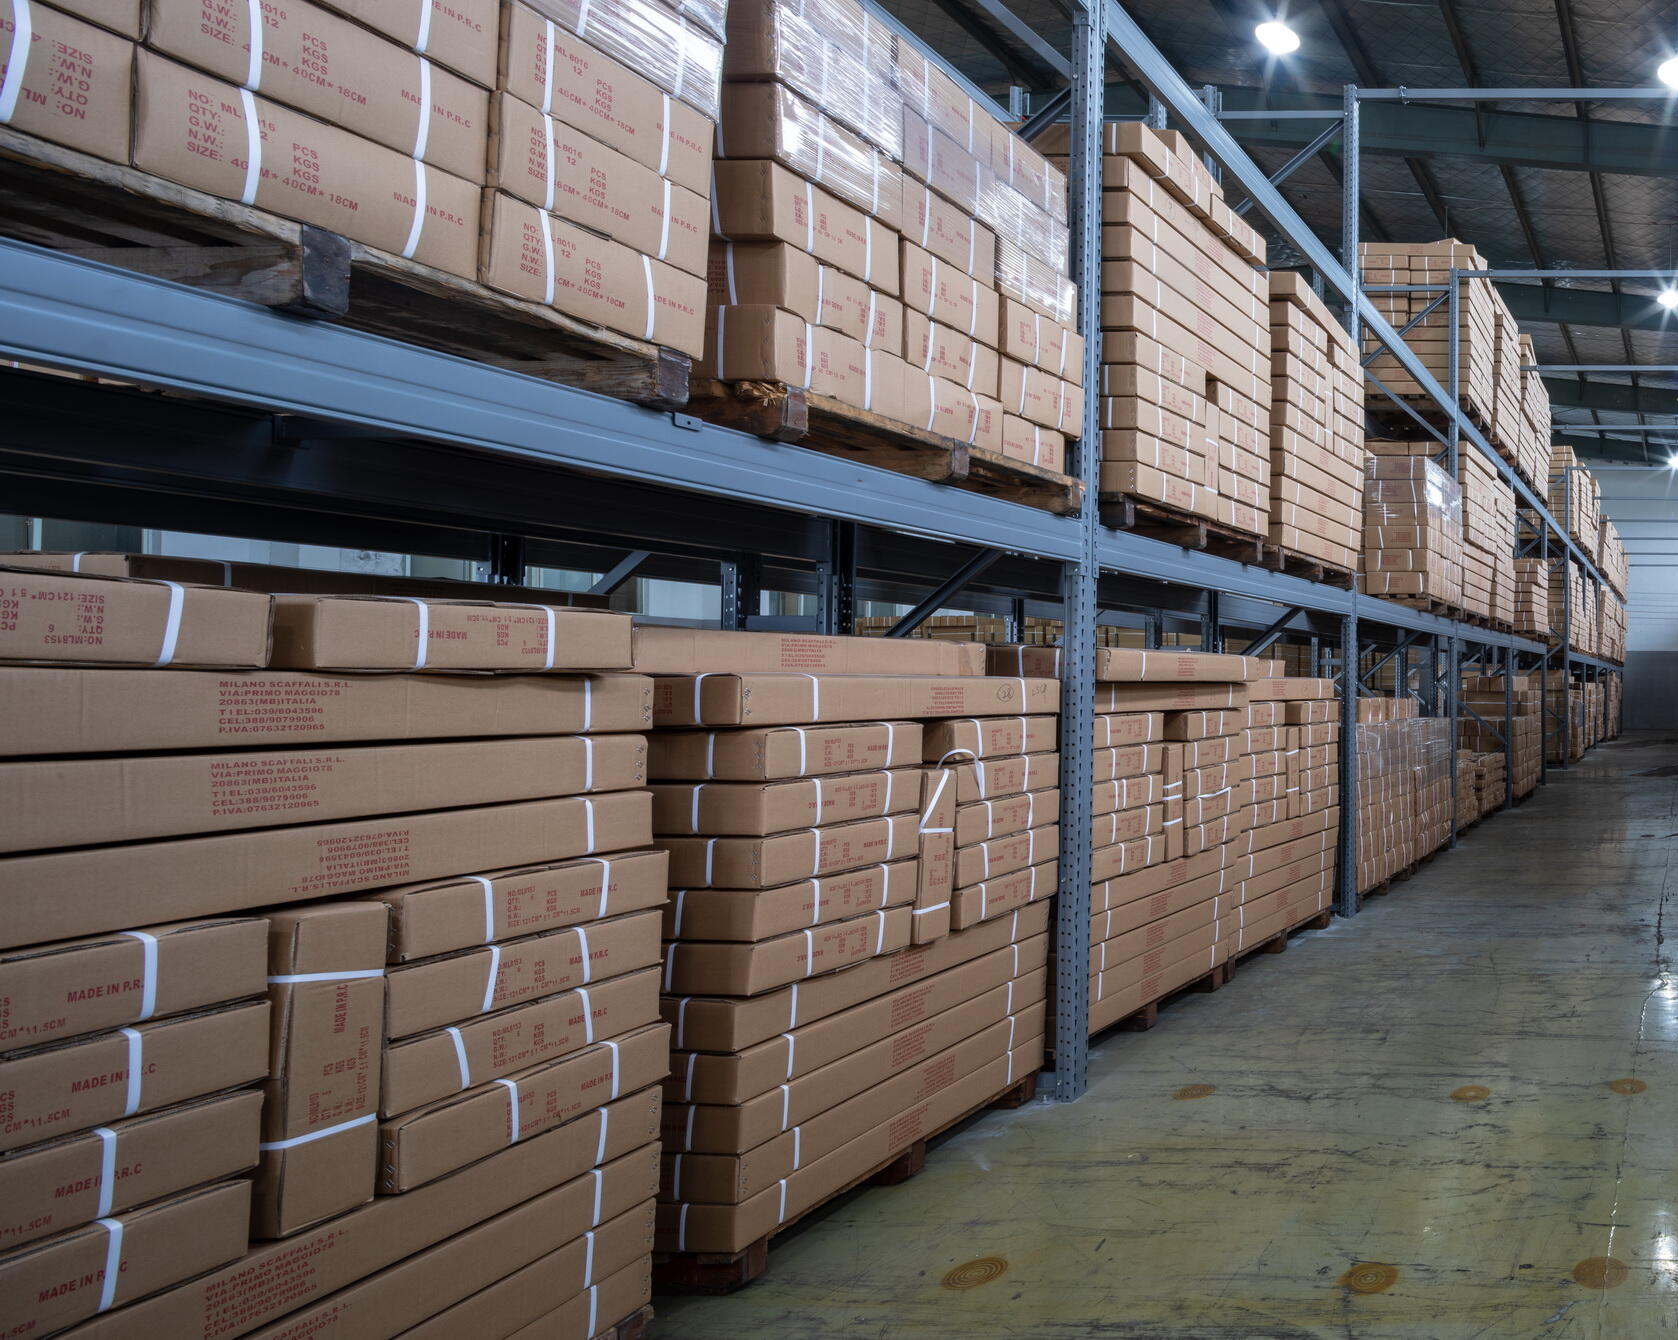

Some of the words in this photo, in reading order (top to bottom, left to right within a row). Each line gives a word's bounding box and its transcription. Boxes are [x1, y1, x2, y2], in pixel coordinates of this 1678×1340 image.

[444, 8, 455, 18] IN
[264, 15, 279, 28] 12
[302, 32, 328, 50] PCS
[302, 45, 328, 63] KGS
[201, 23, 234, 46] SIZE:
[337, 85, 367, 105] 18CM
[302, 57, 328, 75] KGS
[596, 79, 613, 93] PCS
[56, 102, 86, 120] NO:
[188, 89, 214, 107] NO:
[221, 102, 241, 118] ML
[433, 105, 444, 116] IN
[188, 103, 221, 122] QTY:
[292, 143, 318, 159] PCS
[293, 155, 320, 172] KGS
[566, 156, 577, 166] 12
[591, 168, 607, 180] PCS
[186, 141, 223, 162] SIZE:
[329, 193, 359, 211] 18CM
[293, 167, 320, 184] KGS
[590, 177, 607, 191] KGS
[589, 187, 606, 199] KGS
[426, 205, 437, 216] IN
[560, 249, 571, 258] 12
[585, 258, 601, 270] PCS
[520, 262, 542, 277] SIZE:
[585, 268, 602, 280] KGS
[584, 278, 601, 289] KGS
[210, 761, 258, 769] MILANO
[261, 758, 313, 767] SCAFFALI
[373, 870, 410, 881] MILANO
[67, 987, 104, 1003] MADE
[107, 983, 120, 994] IN
[334, 1012, 347, 1034] MADE
[568, 1015, 584, 1026] MADE
[71, 1075, 111, 1093] MADE
[110, 1070, 123, 1083] IN
[54, 1176, 92, 1199] MADE
[206, 1267, 256, 1293] MILANO
[258, 1242, 314, 1269] SCAFFALI
[38, 1280, 76, 1304] MADE
[79, 1272, 93, 1289] IN
